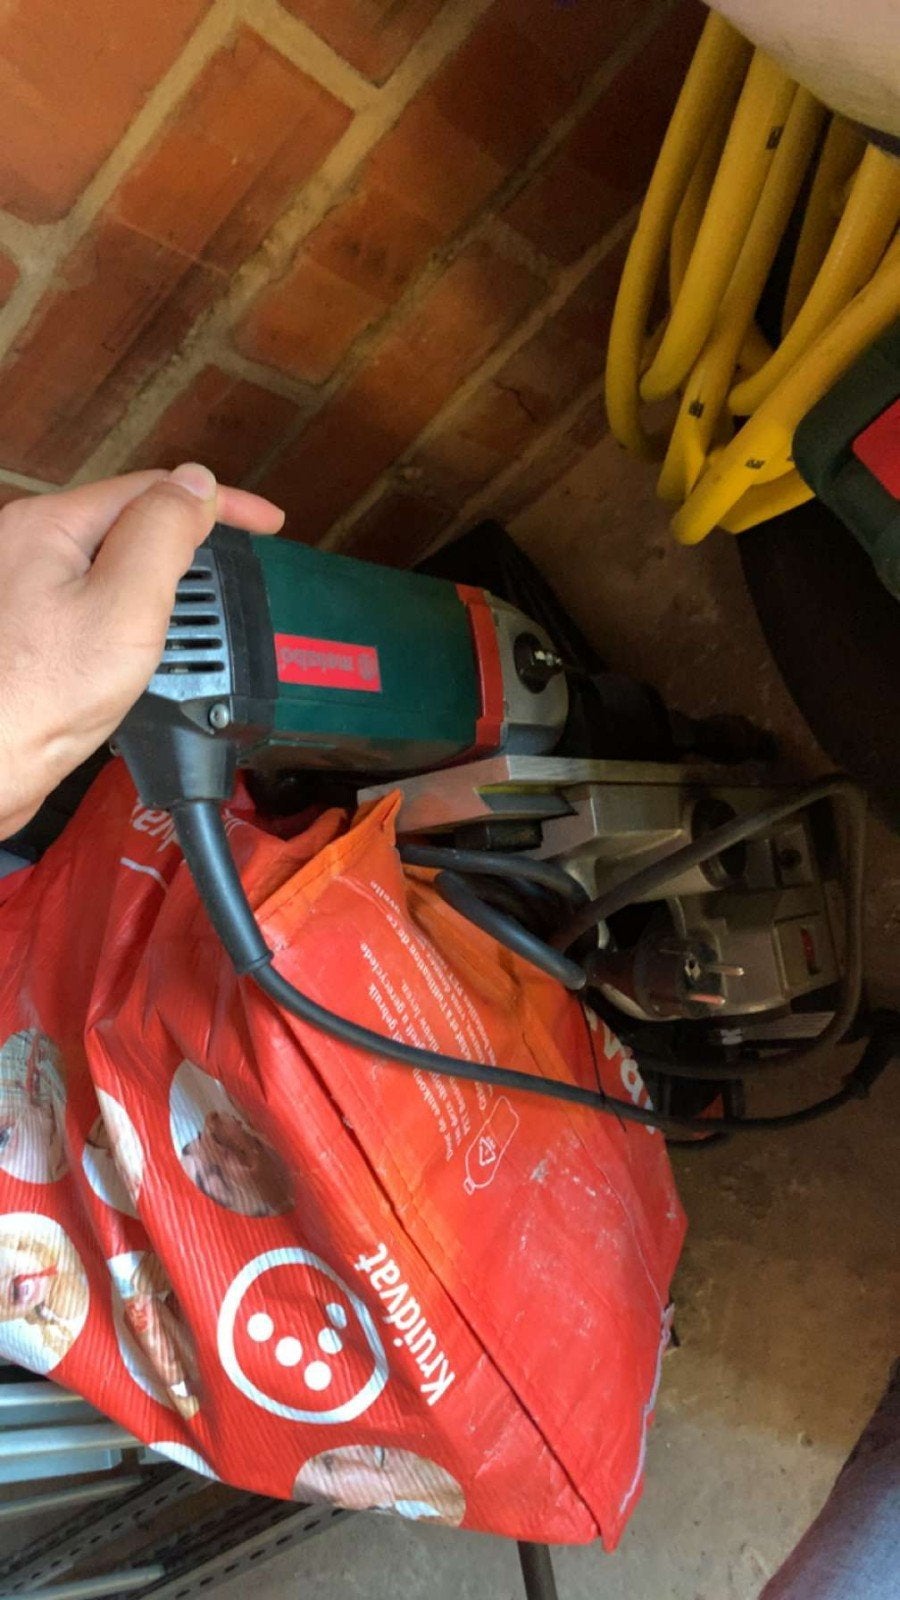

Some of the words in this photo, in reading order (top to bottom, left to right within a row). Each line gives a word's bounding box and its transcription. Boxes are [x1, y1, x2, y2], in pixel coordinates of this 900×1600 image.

[360, 942, 406, 1014] gerecyclede
[368, 981, 398, 1031] gebruik
[420, 1016, 440, 1053] nieuw
[353, 1241, 457, 1408] Kruidvat
